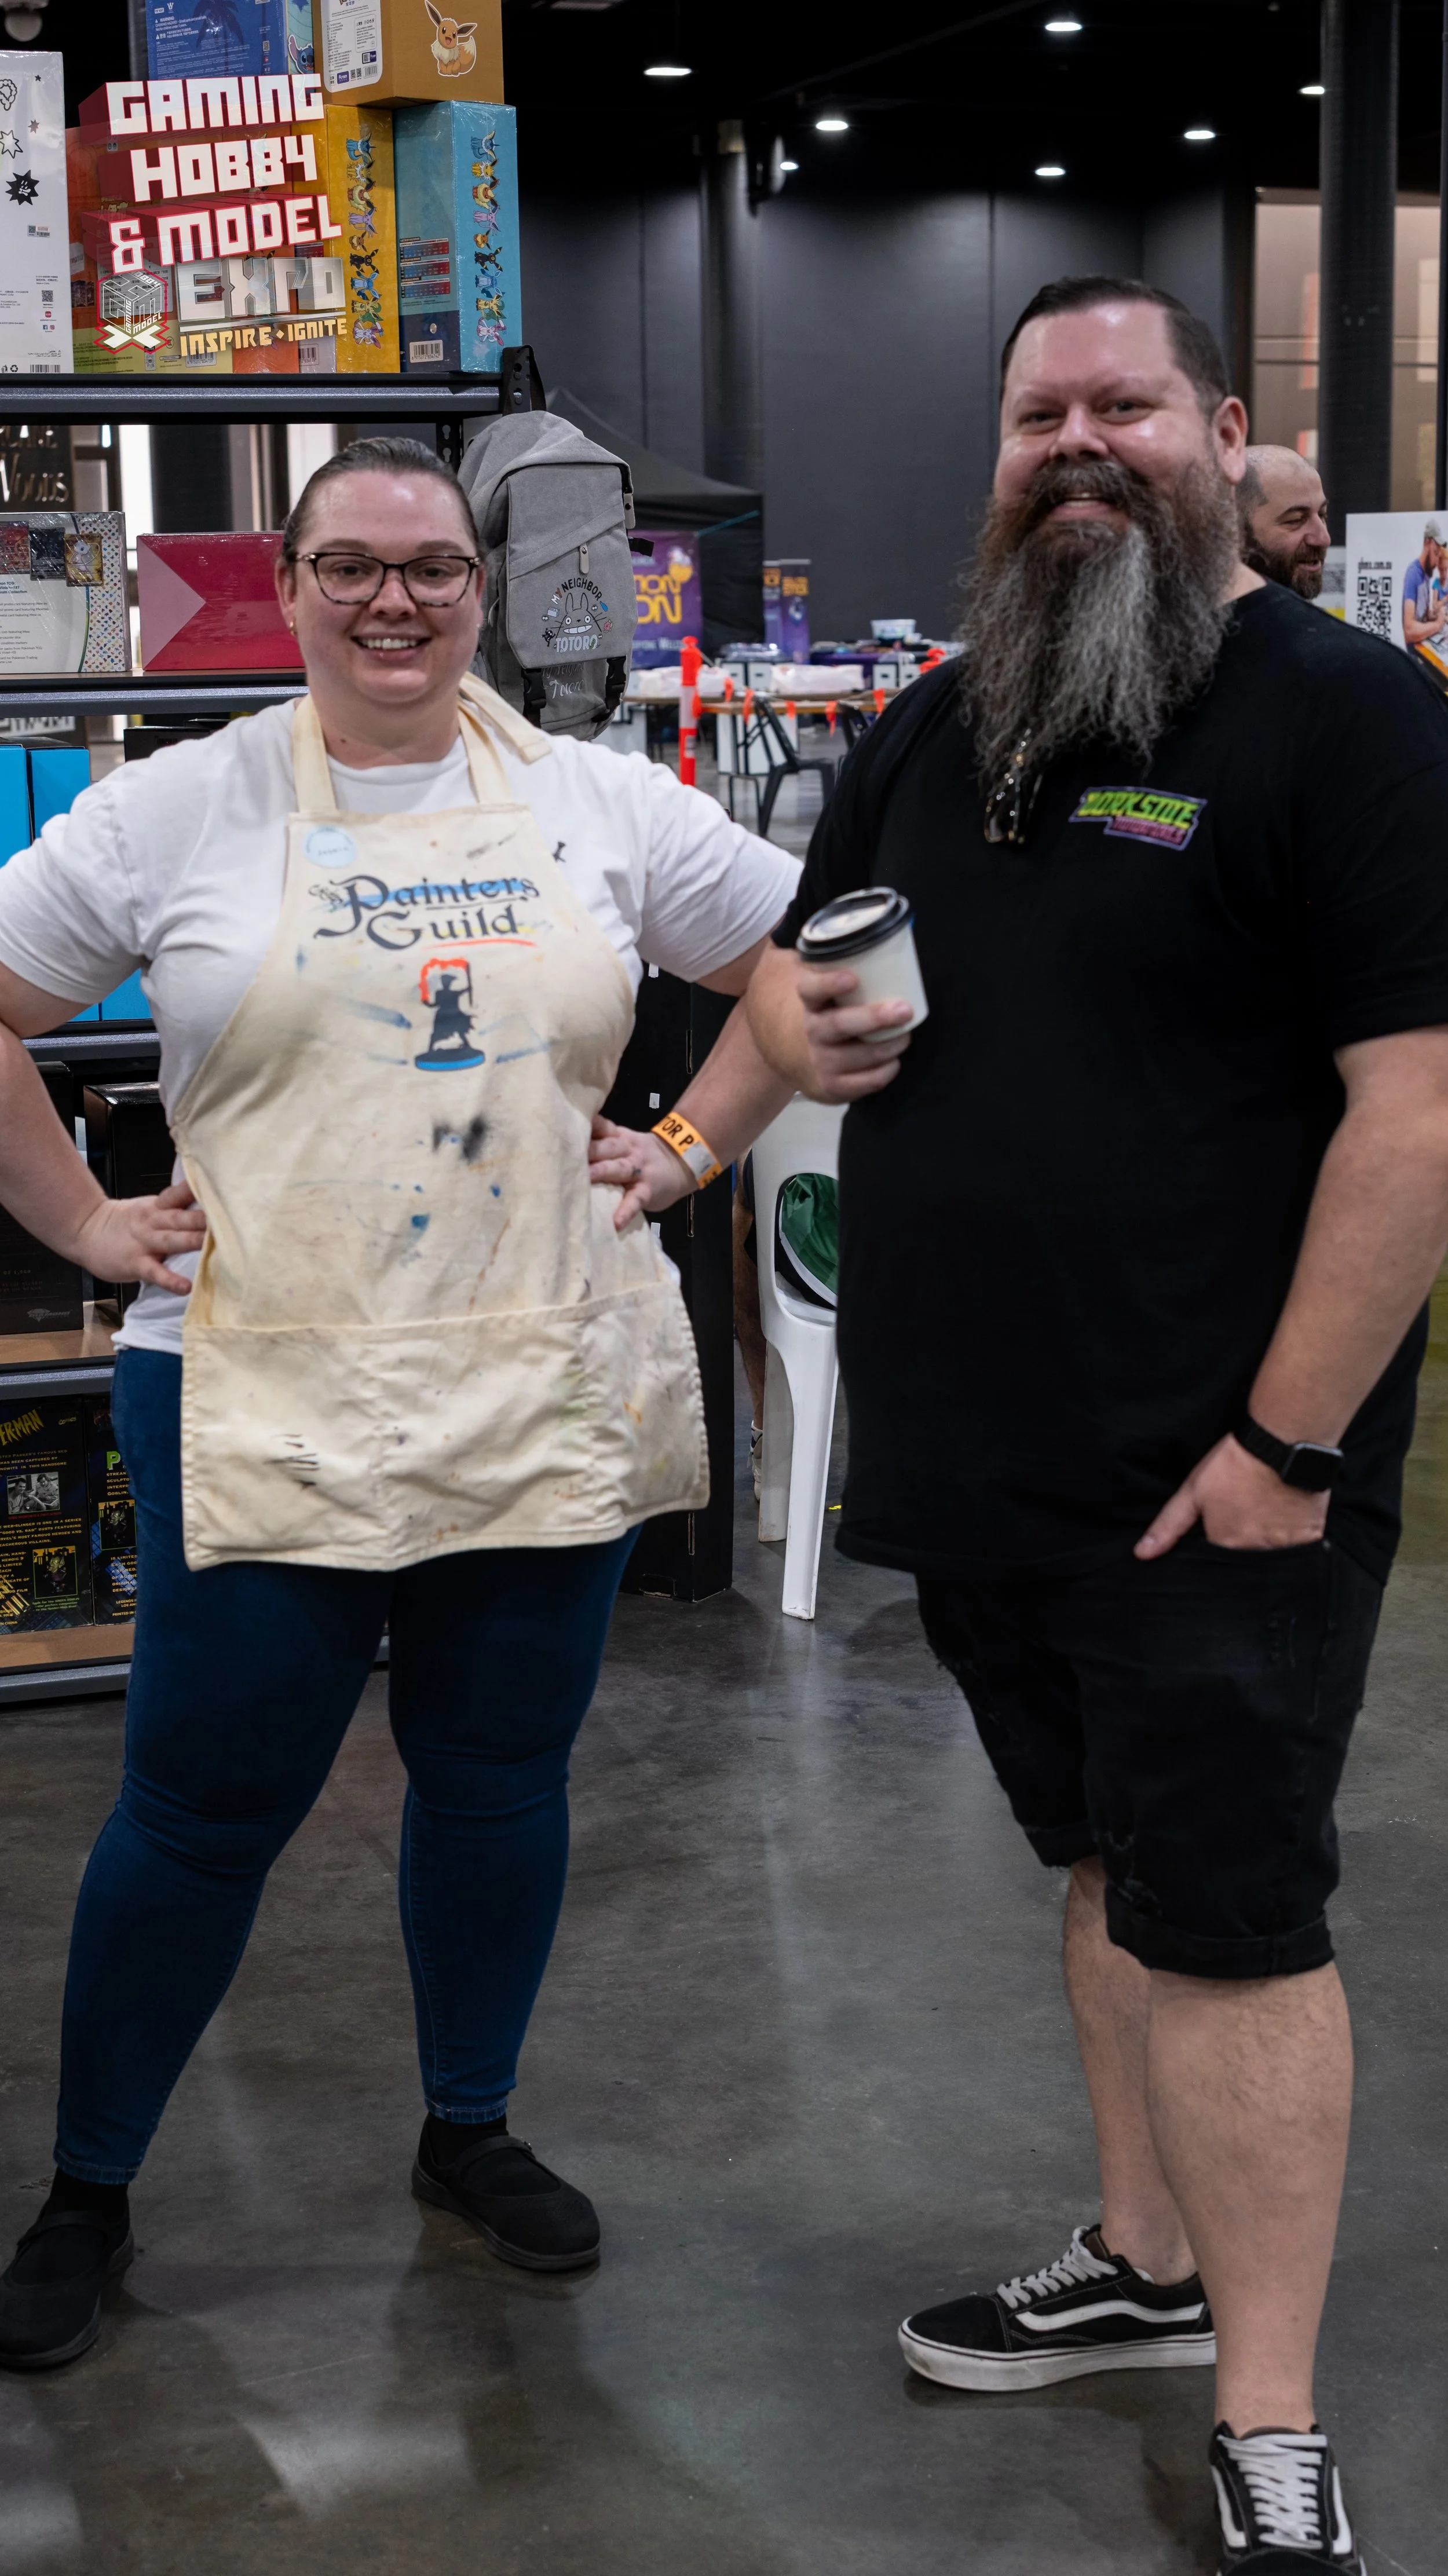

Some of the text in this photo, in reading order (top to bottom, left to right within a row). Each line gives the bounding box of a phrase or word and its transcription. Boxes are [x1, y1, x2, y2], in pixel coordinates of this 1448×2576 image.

[551, 577, 602, 605] MY NEIGHBOR
[555, 634, 598, 653] TOTORO
[313, 874, 540, 939] Painters
[367, 903, 522, 950] Guild
[0, 1409, 44, 1446] ER-MAN
